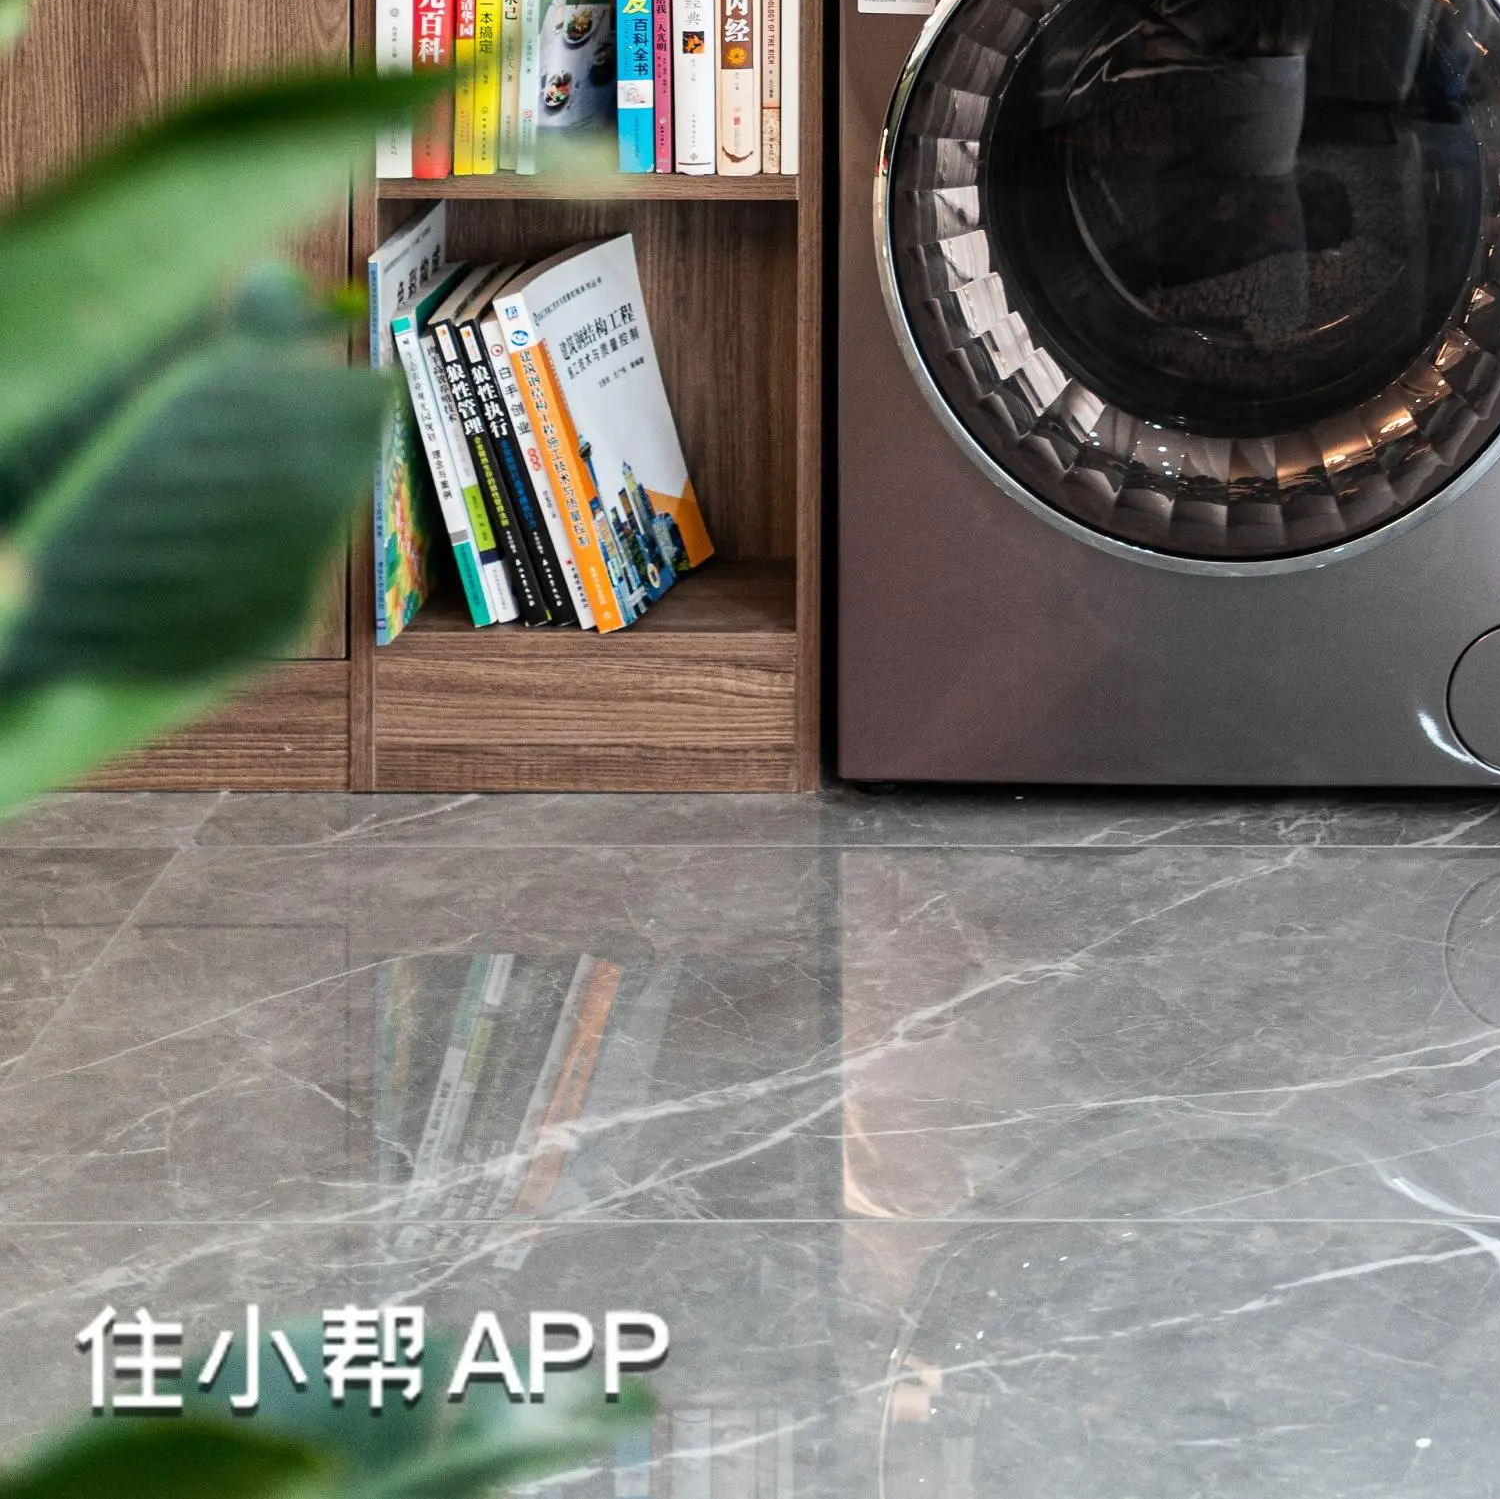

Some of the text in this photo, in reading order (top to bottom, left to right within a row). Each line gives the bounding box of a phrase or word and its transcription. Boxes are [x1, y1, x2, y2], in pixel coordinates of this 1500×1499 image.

[479, 2, 494, 54] 一本搞定
[632, 17, 649, 77] 百科全书
[558, 302, 637, 361] 建筑钢结构工程
[446, 363, 485, 437] 狼性管理
[470, 364, 509, 439] 狼性执行
[498, 366, 534, 437] 白手创业
